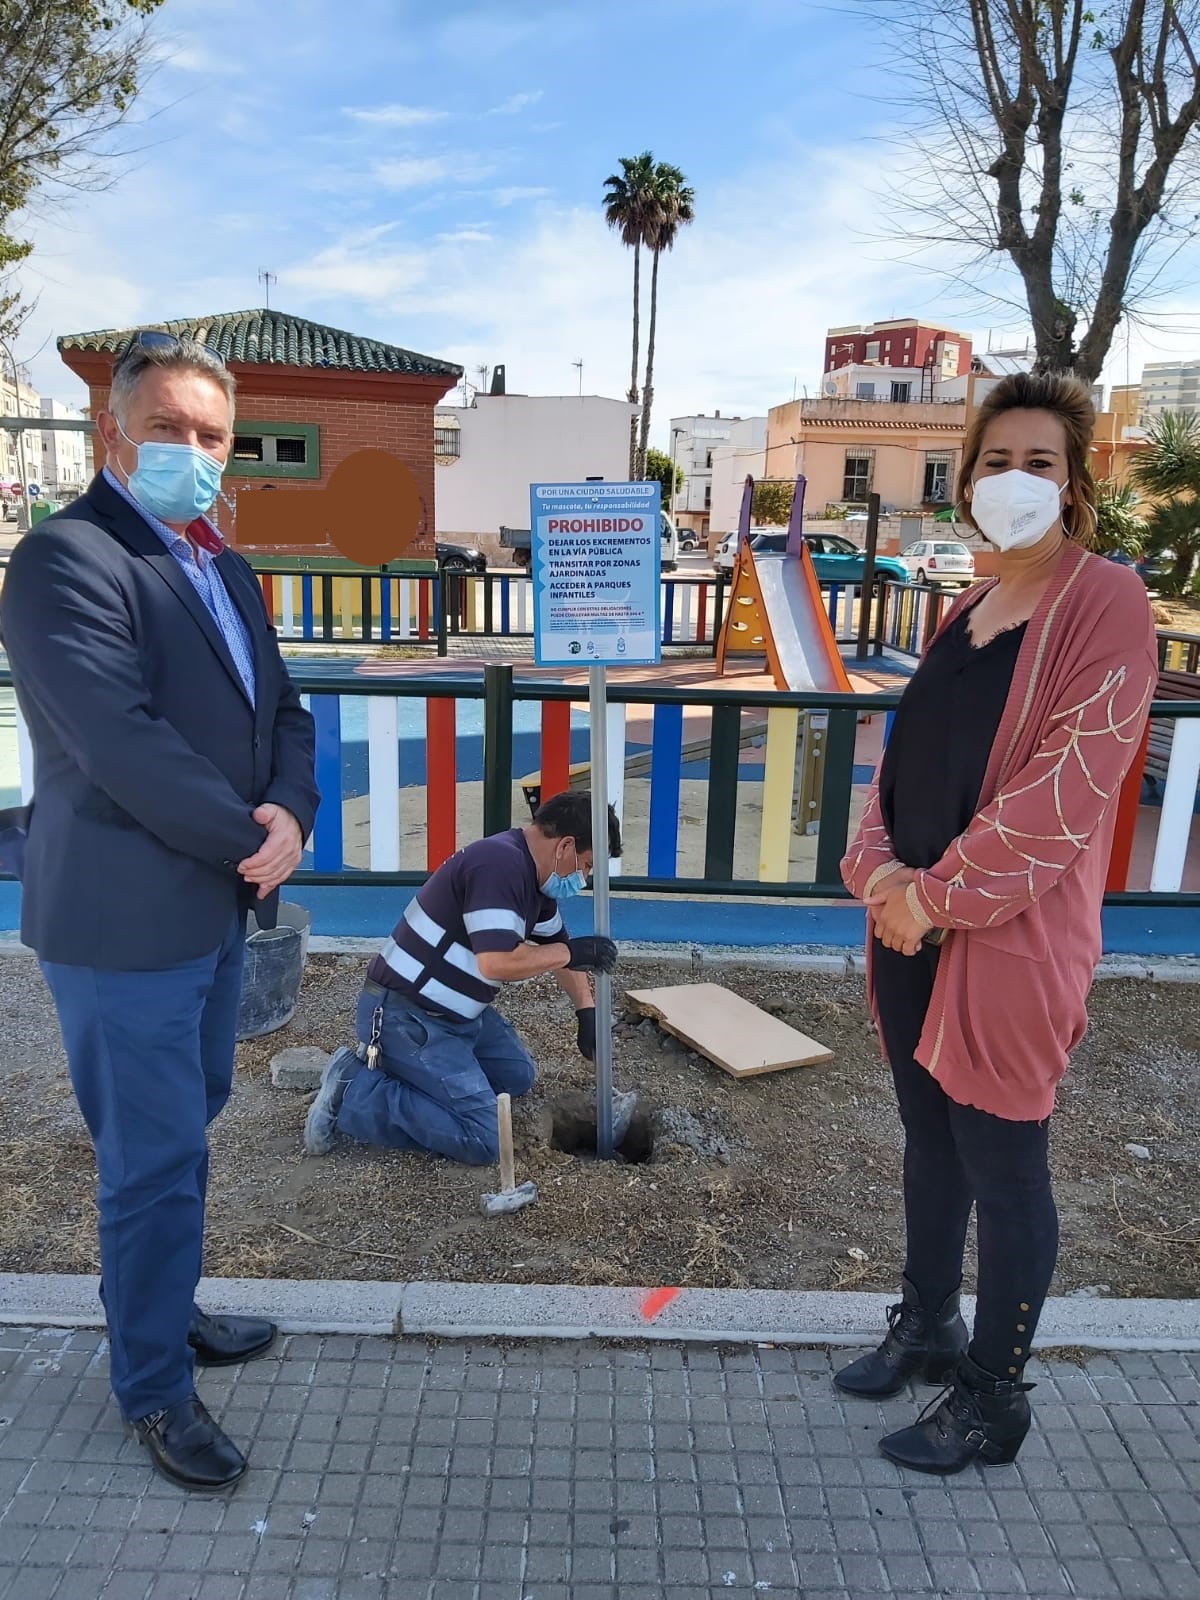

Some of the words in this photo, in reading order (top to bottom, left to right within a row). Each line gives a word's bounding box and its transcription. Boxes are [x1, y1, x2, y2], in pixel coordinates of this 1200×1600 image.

[541, 488, 556, 496] POR
[559, 488, 574, 496] UNA
[576, 487, 605, 496] CIUDAD
[606, 487, 649, 495] SALUDABLE
[552, 503, 583, 511] mascota,
[593, 501, 650, 511] responsabilidad
[548, 518, 644, 533] PROHIBIDO
[576, 538, 591, 546] LOS
[593, 537, 651, 545] EXCREMENTOS
[549, 548, 560, 556] EN
[561, 548, 571, 556] LA
[573, 546, 587, 556] VÍA
[588, 546, 623, 555] PÚBLICA
[549, 560, 594, 568] TRANSITAR
[613, 559, 641, 567] ZONAS
[549, 569, 607, 577] AJARDINADAS
[587, 581, 593, 589] A
[594, 581, 632, 589] PARQUES
[550, 591, 596, 599] INFANTILES
